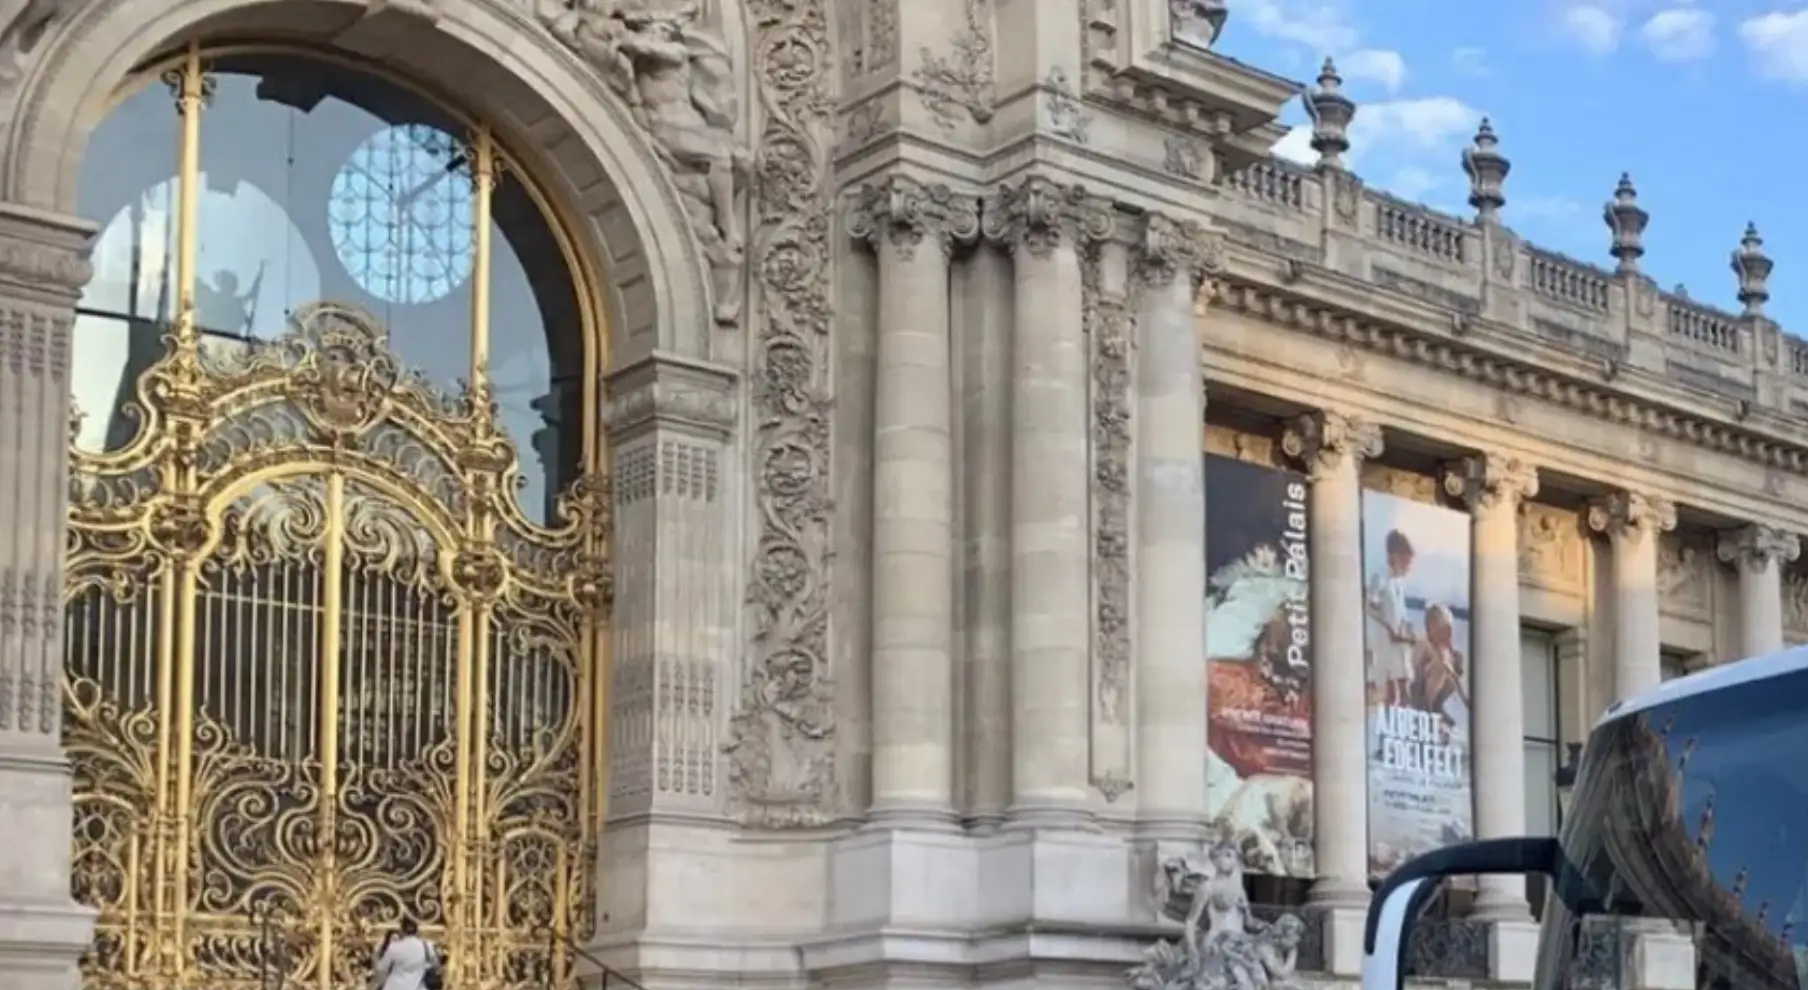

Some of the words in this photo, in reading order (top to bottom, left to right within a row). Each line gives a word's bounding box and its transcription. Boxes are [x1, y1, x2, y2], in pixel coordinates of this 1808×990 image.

[1282, 482, 1308, 581] Palais
[1288, 595, 1309, 669] Petit
[1376, 702, 1442, 744] ALBERT
[1382, 737, 1463, 786] EDELFELT
